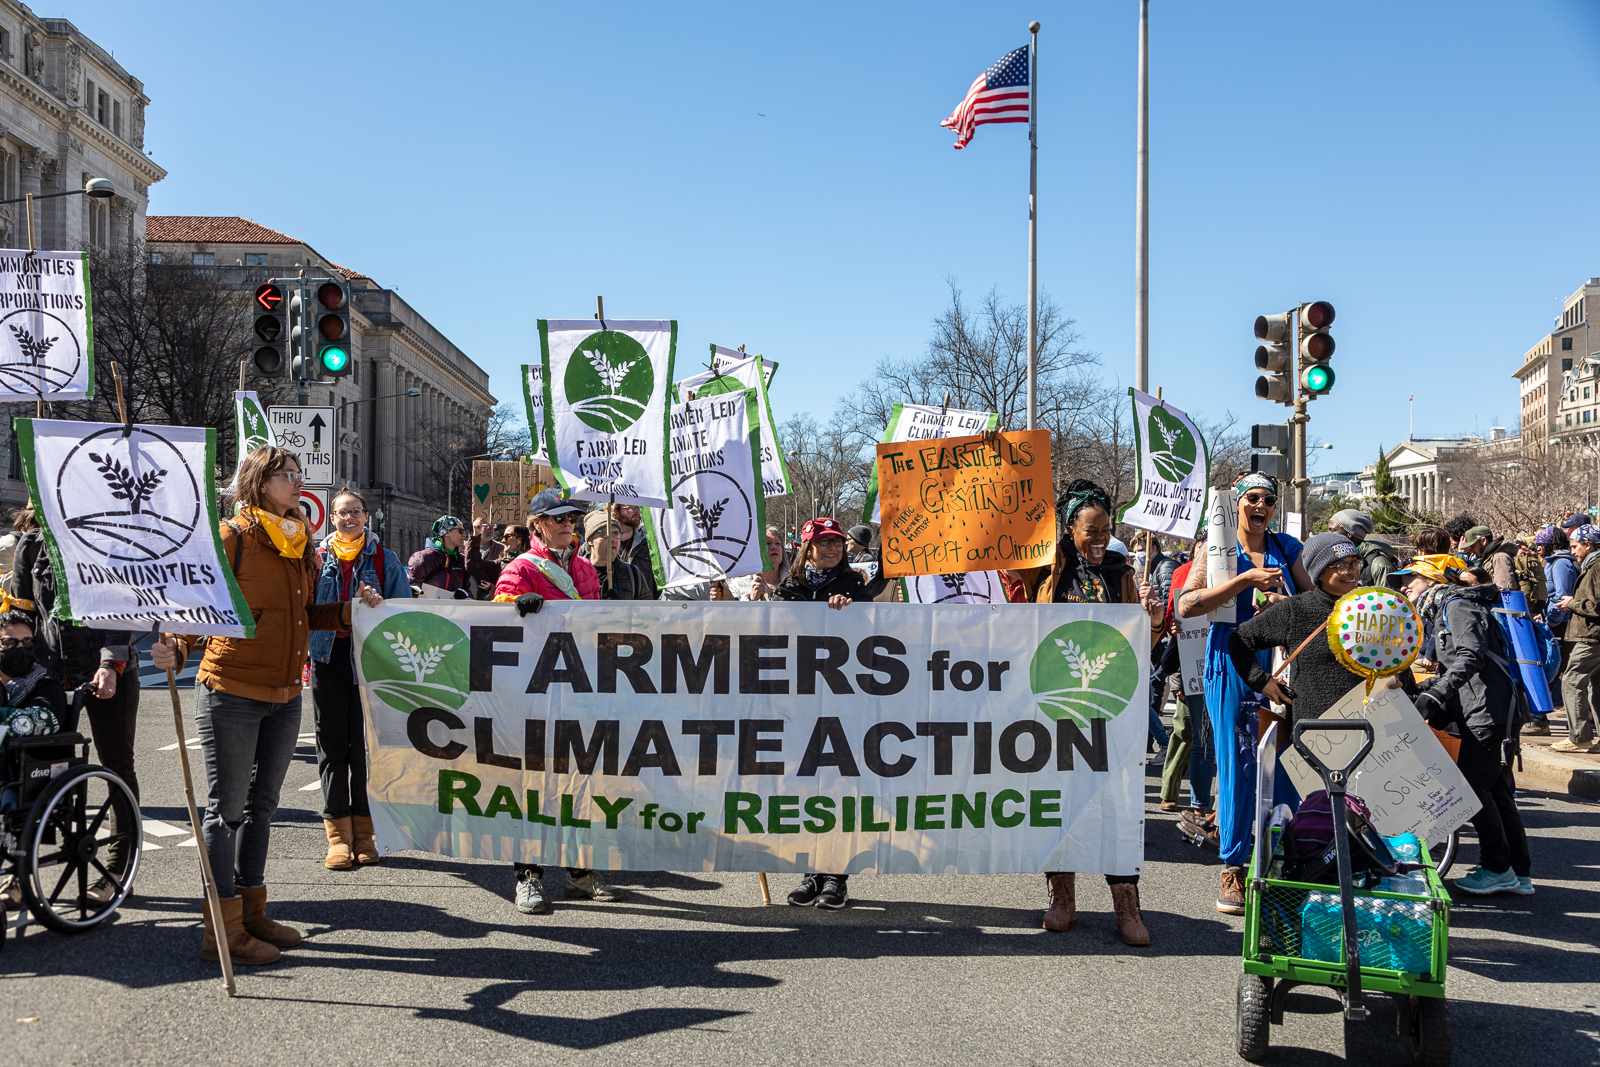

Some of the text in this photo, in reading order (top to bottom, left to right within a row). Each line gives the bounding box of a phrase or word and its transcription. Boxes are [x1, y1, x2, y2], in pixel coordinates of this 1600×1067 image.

[16, 274, 41, 290] NOT
[272, 411, 302, 425] THRU
[670, 400, 736, 431] RMER LED
[912, 411, 980, 430] FARMER LED
[908, 425, 951, 440] CLIMATE
[576, 436, 647, 458] FARMR LED
[919, 439, 1002, 472] EARTH
[1009, 441, 1036, 467] IS
[306, 452, 331, 465] THIS
[474, 466, 539, 479] DECOLONIZE
[495, 482, 520, 494] OUR
[1170, 483, 1203, 503] JUSTICE
[491, 495, 519, 506] FOOD
[1142, 498, 1169, 517] FARM
[1170, 503, 1191, 521] BILL
[885, 537, 963, 574] Support
[76, 562, 216, 587] COMMUNITIES
[131, 585, 170, 607] NOT
[1356, 612, 1407, 636] HAPPY
[469, 625, 1010, 696] FARMERS for
[406, 706, 1110, 778] CLIMATE ACTION
[30, 768, 51, 778] drive
[1383, 763, 1442, 805] Solvers
[438, 769, 1062, 834] RALLY for RESILIENCE
